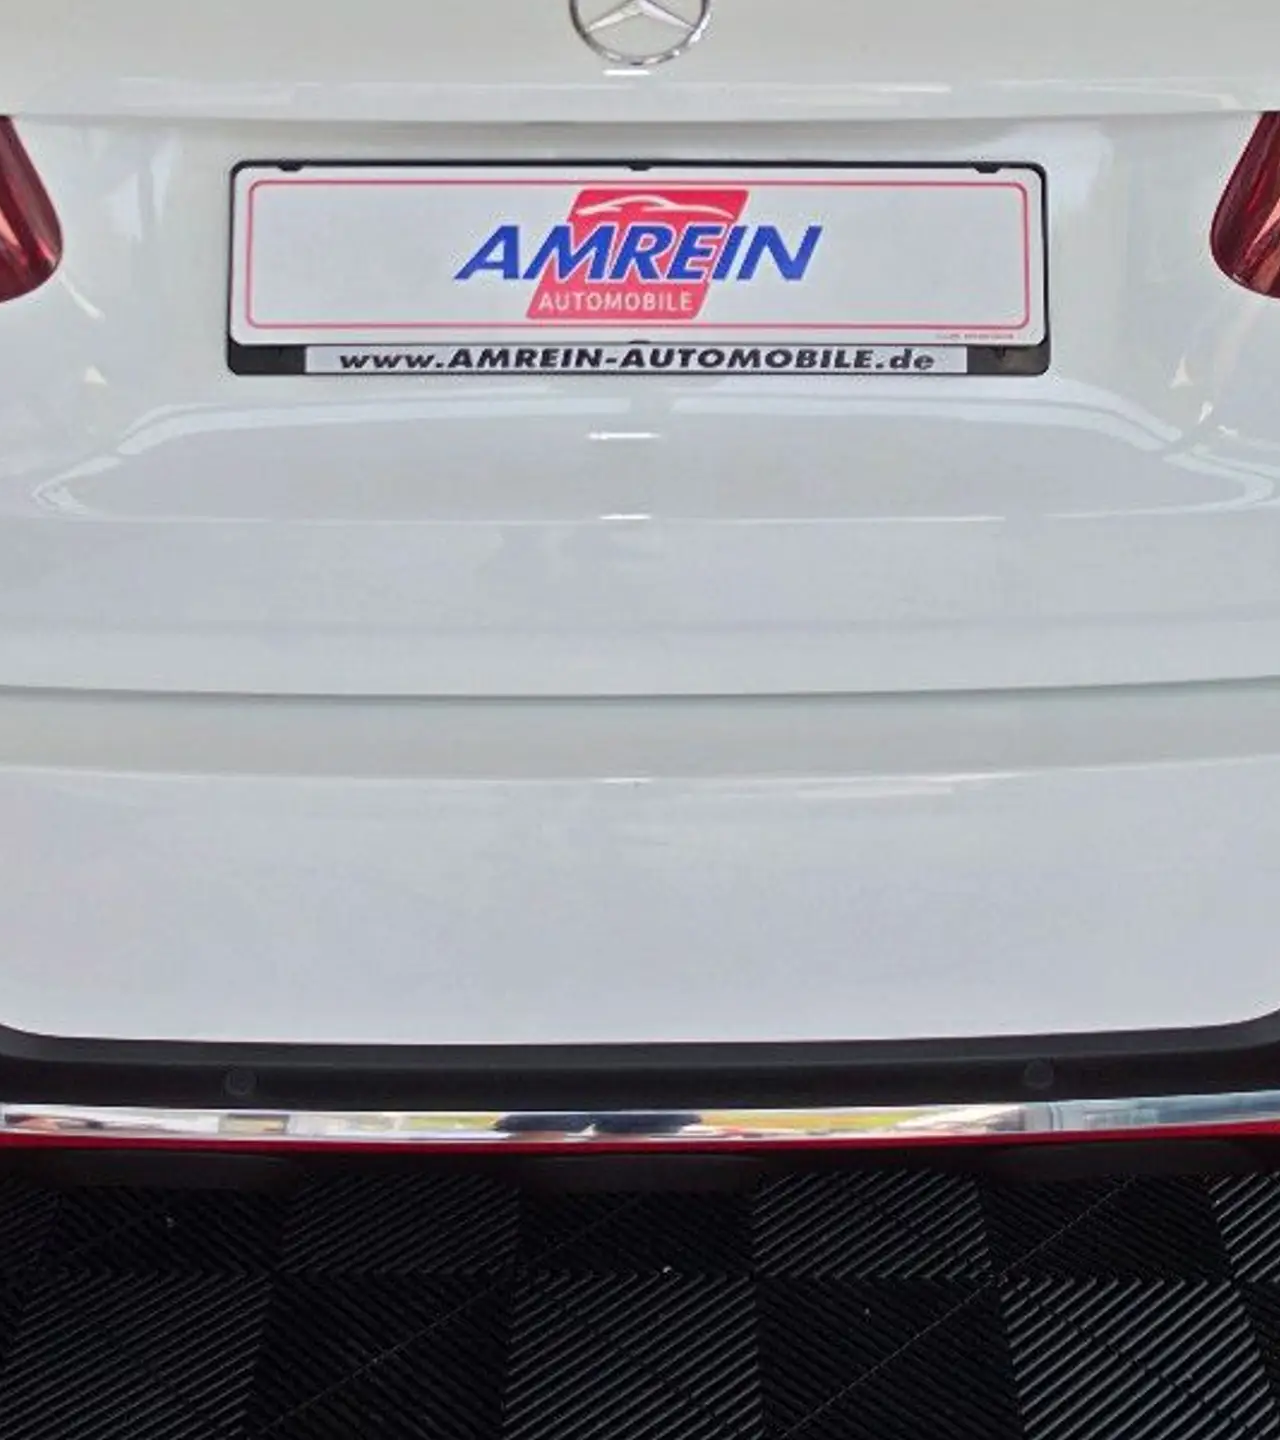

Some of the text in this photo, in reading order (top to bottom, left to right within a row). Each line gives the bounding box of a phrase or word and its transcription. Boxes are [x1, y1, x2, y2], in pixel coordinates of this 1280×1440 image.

[453, 224, 823, 281] AMREIN
[537, 291, 694, 312] AUTOMOBILE
[339, 347, 935, 371] www.AMREIN-AUTOMOBILE.de
